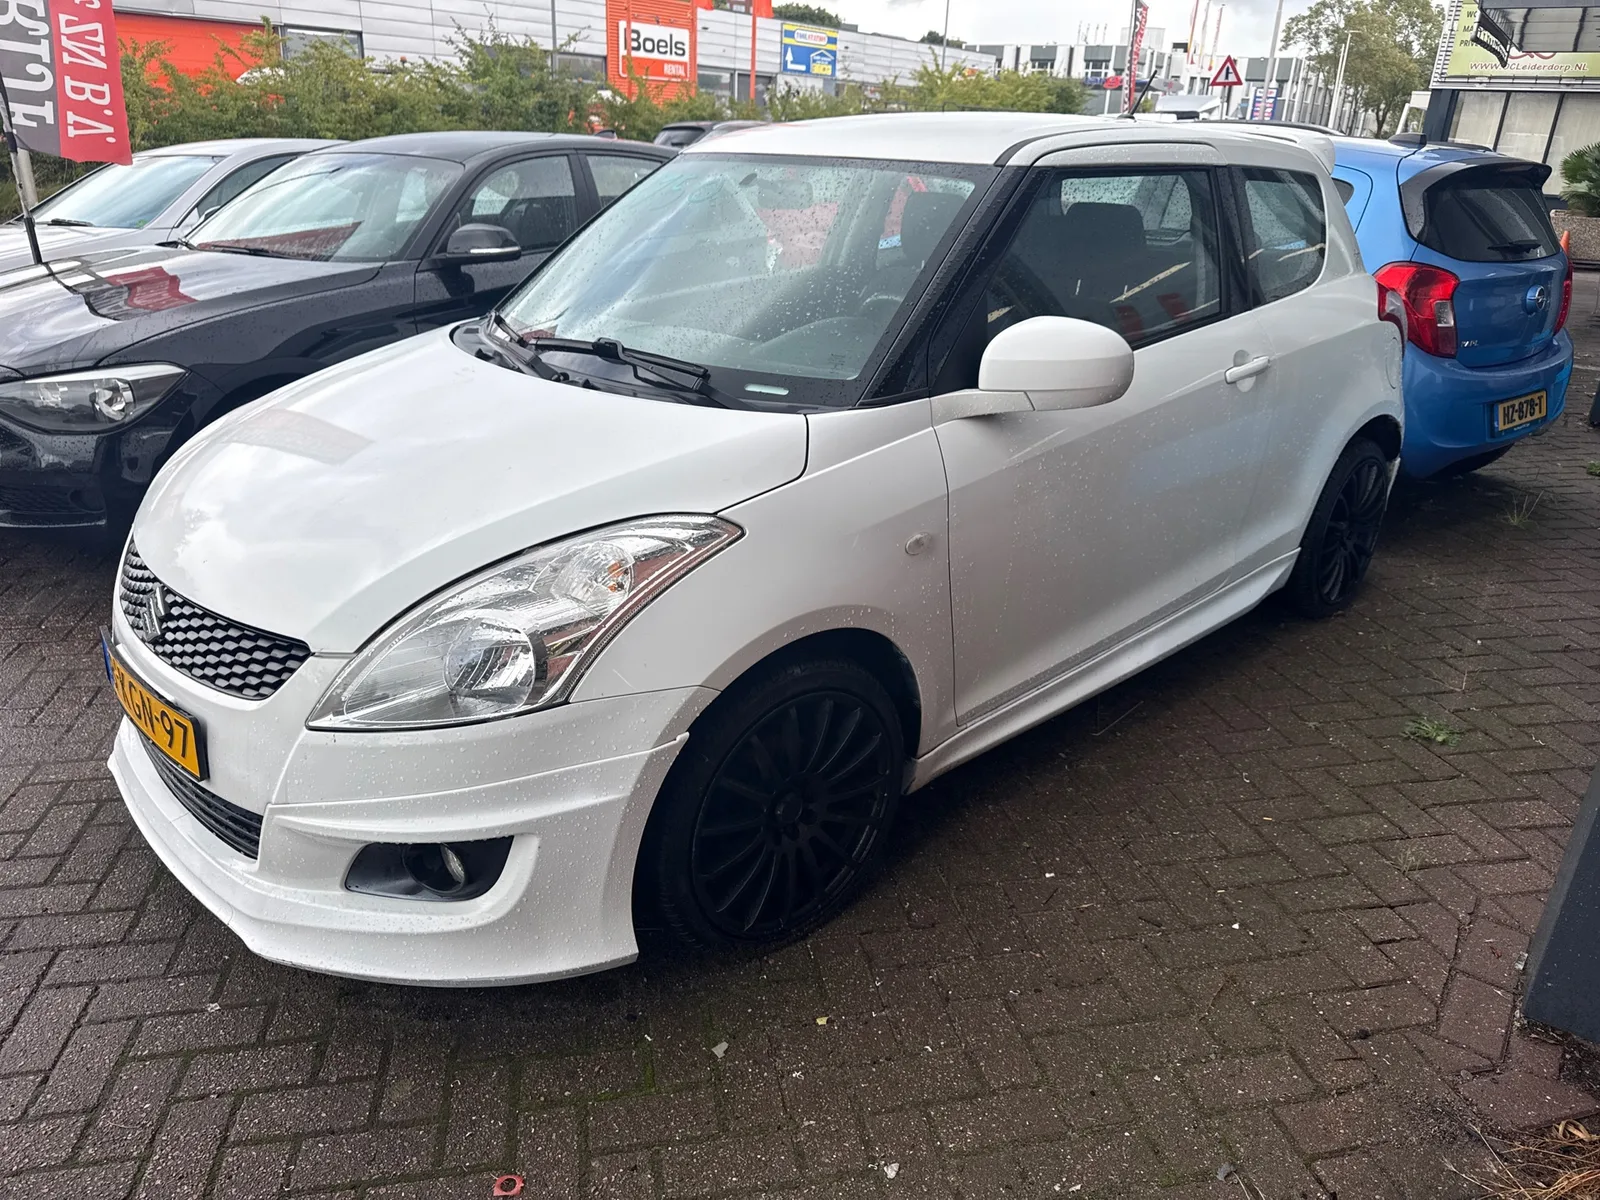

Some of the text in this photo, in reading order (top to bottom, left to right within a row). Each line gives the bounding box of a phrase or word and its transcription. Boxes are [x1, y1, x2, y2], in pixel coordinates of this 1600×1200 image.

[624, 27, 686, 57] Boels
[663, 62, 686, 77] RENTAL
[1502, 394, 1544, 427] HZ-878-T
